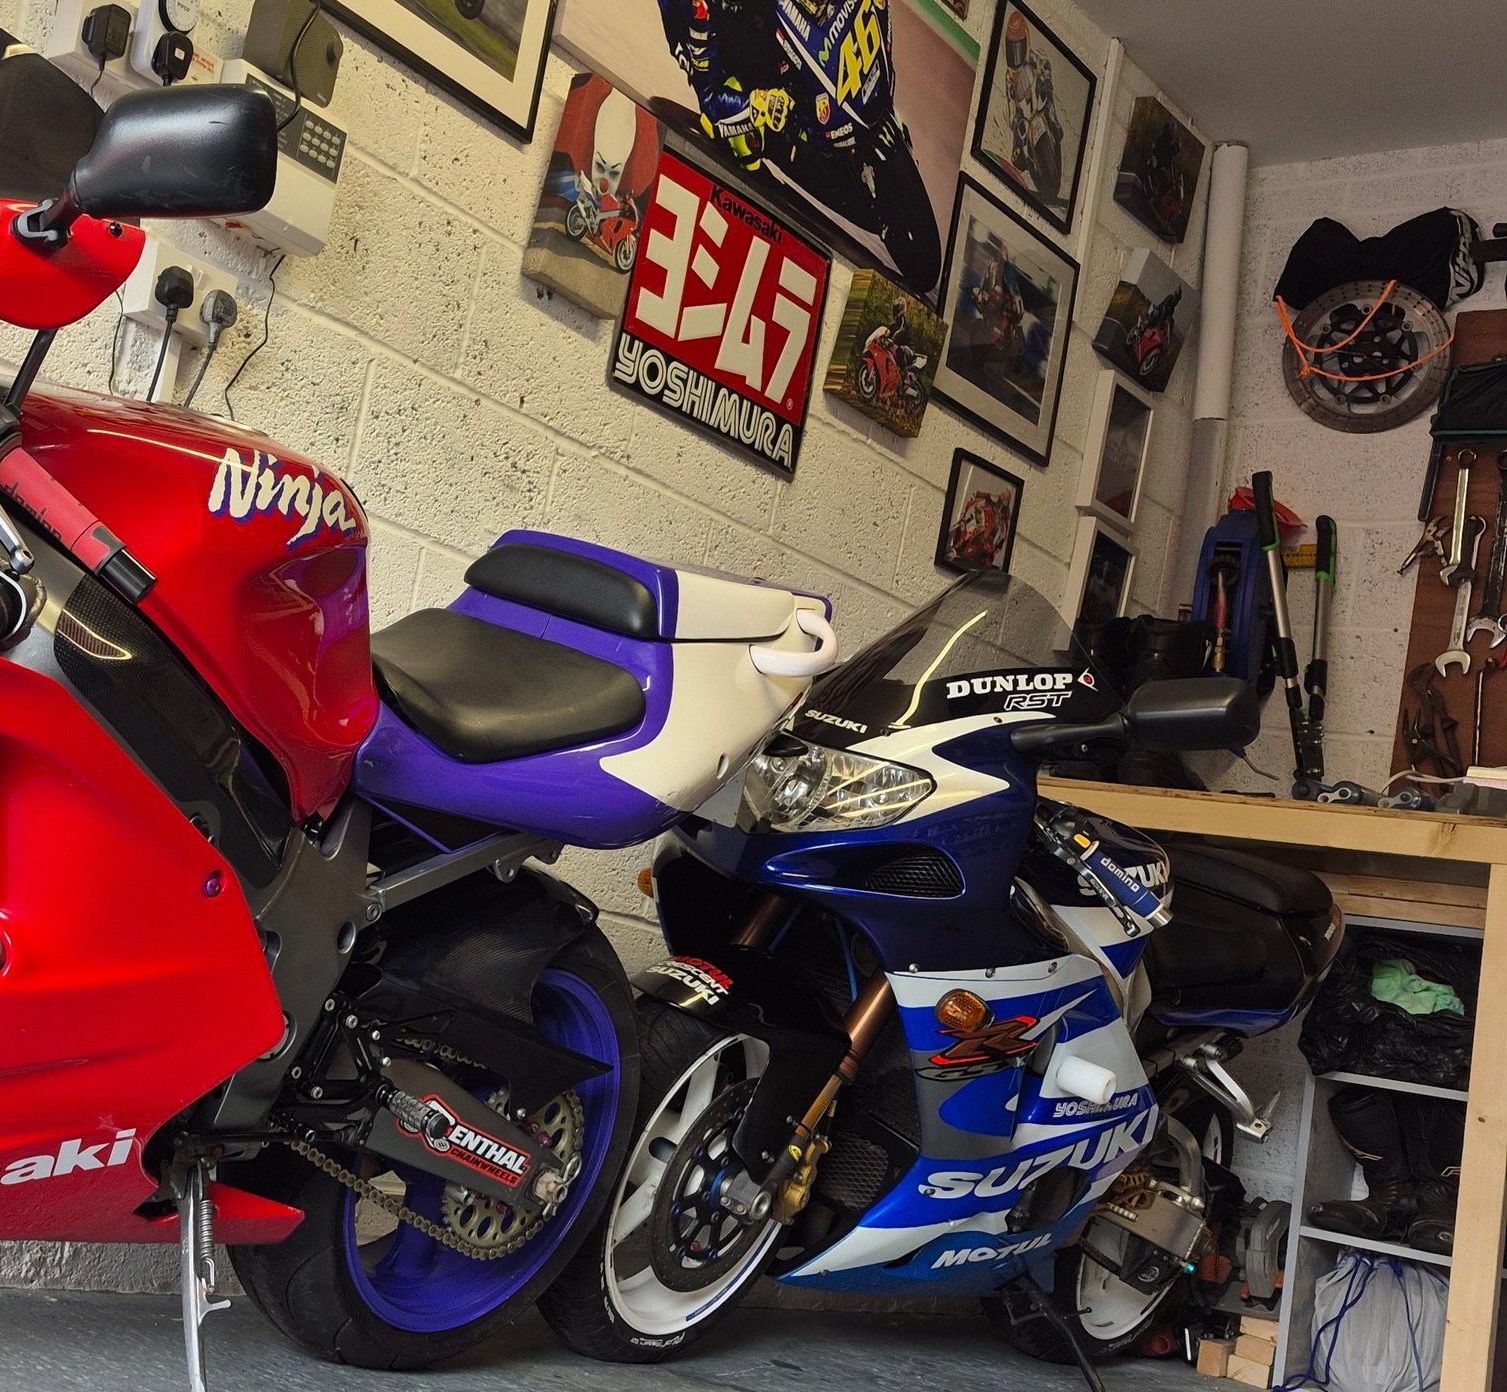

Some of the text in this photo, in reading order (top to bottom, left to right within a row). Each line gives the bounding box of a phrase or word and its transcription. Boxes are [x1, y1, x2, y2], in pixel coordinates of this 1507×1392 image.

[836, 0, 881, 107] 46
[831, 122, 854, 139] ENEOS
[710, 184, 783, 245] Kawasaki
[614, 333, 793, 472] YOSHIMURA
[207, 446, 357, 548] Ninja
[946, 673, 1073, 700] DUNLOP
[1003, 691, 1072, 711] RST
[804, 708, 868, 735] SUZUKI
[1100, 857, 1140, 893] domino
[646, 966, 720, 1005] SUZUKI
[436, 1110, 527, 1175] ENTHAL
[918, 1103, 1160, 1199] SUZUKI
[450, 1148, 518, 1184] CHAINWHEELS
[930, 1233, 1052, 1270] MOTUL
